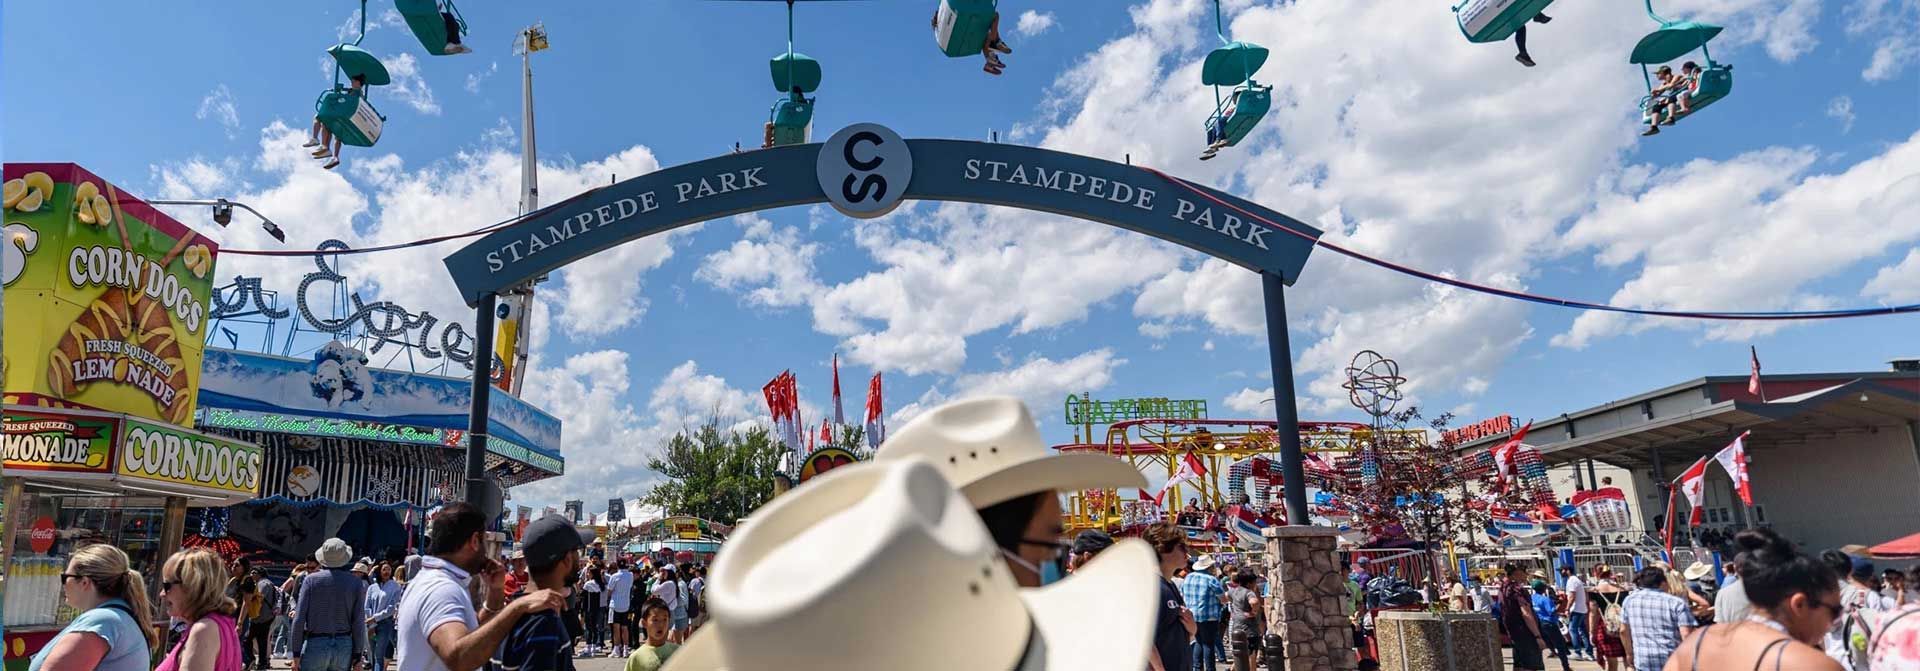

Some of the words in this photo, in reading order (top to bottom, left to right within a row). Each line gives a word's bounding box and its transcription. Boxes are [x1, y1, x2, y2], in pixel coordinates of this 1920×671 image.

[486, 189, 660, 275] STAMPEDE
[673, 166, 768, 204] PARK
[964, 158, 1156, 211] STAMPEDE
[1172, 197, 1274, 251] PARK
[69, 245, 146, 291] CORN
[145, 261, 203, 333] DOGS
[73, 357, 176, 407] LEMONADE
[86, 339, 122, 354] FRESH
[124, 343, 172, 378] SQUEEZED
[0, 432, 90, 464] MONADE
[29, 420, 75, 432] SQUEEZED
[1480, 414, 1511, 437] FOUR
[124, 426, 260, 490] CORNDOGS
